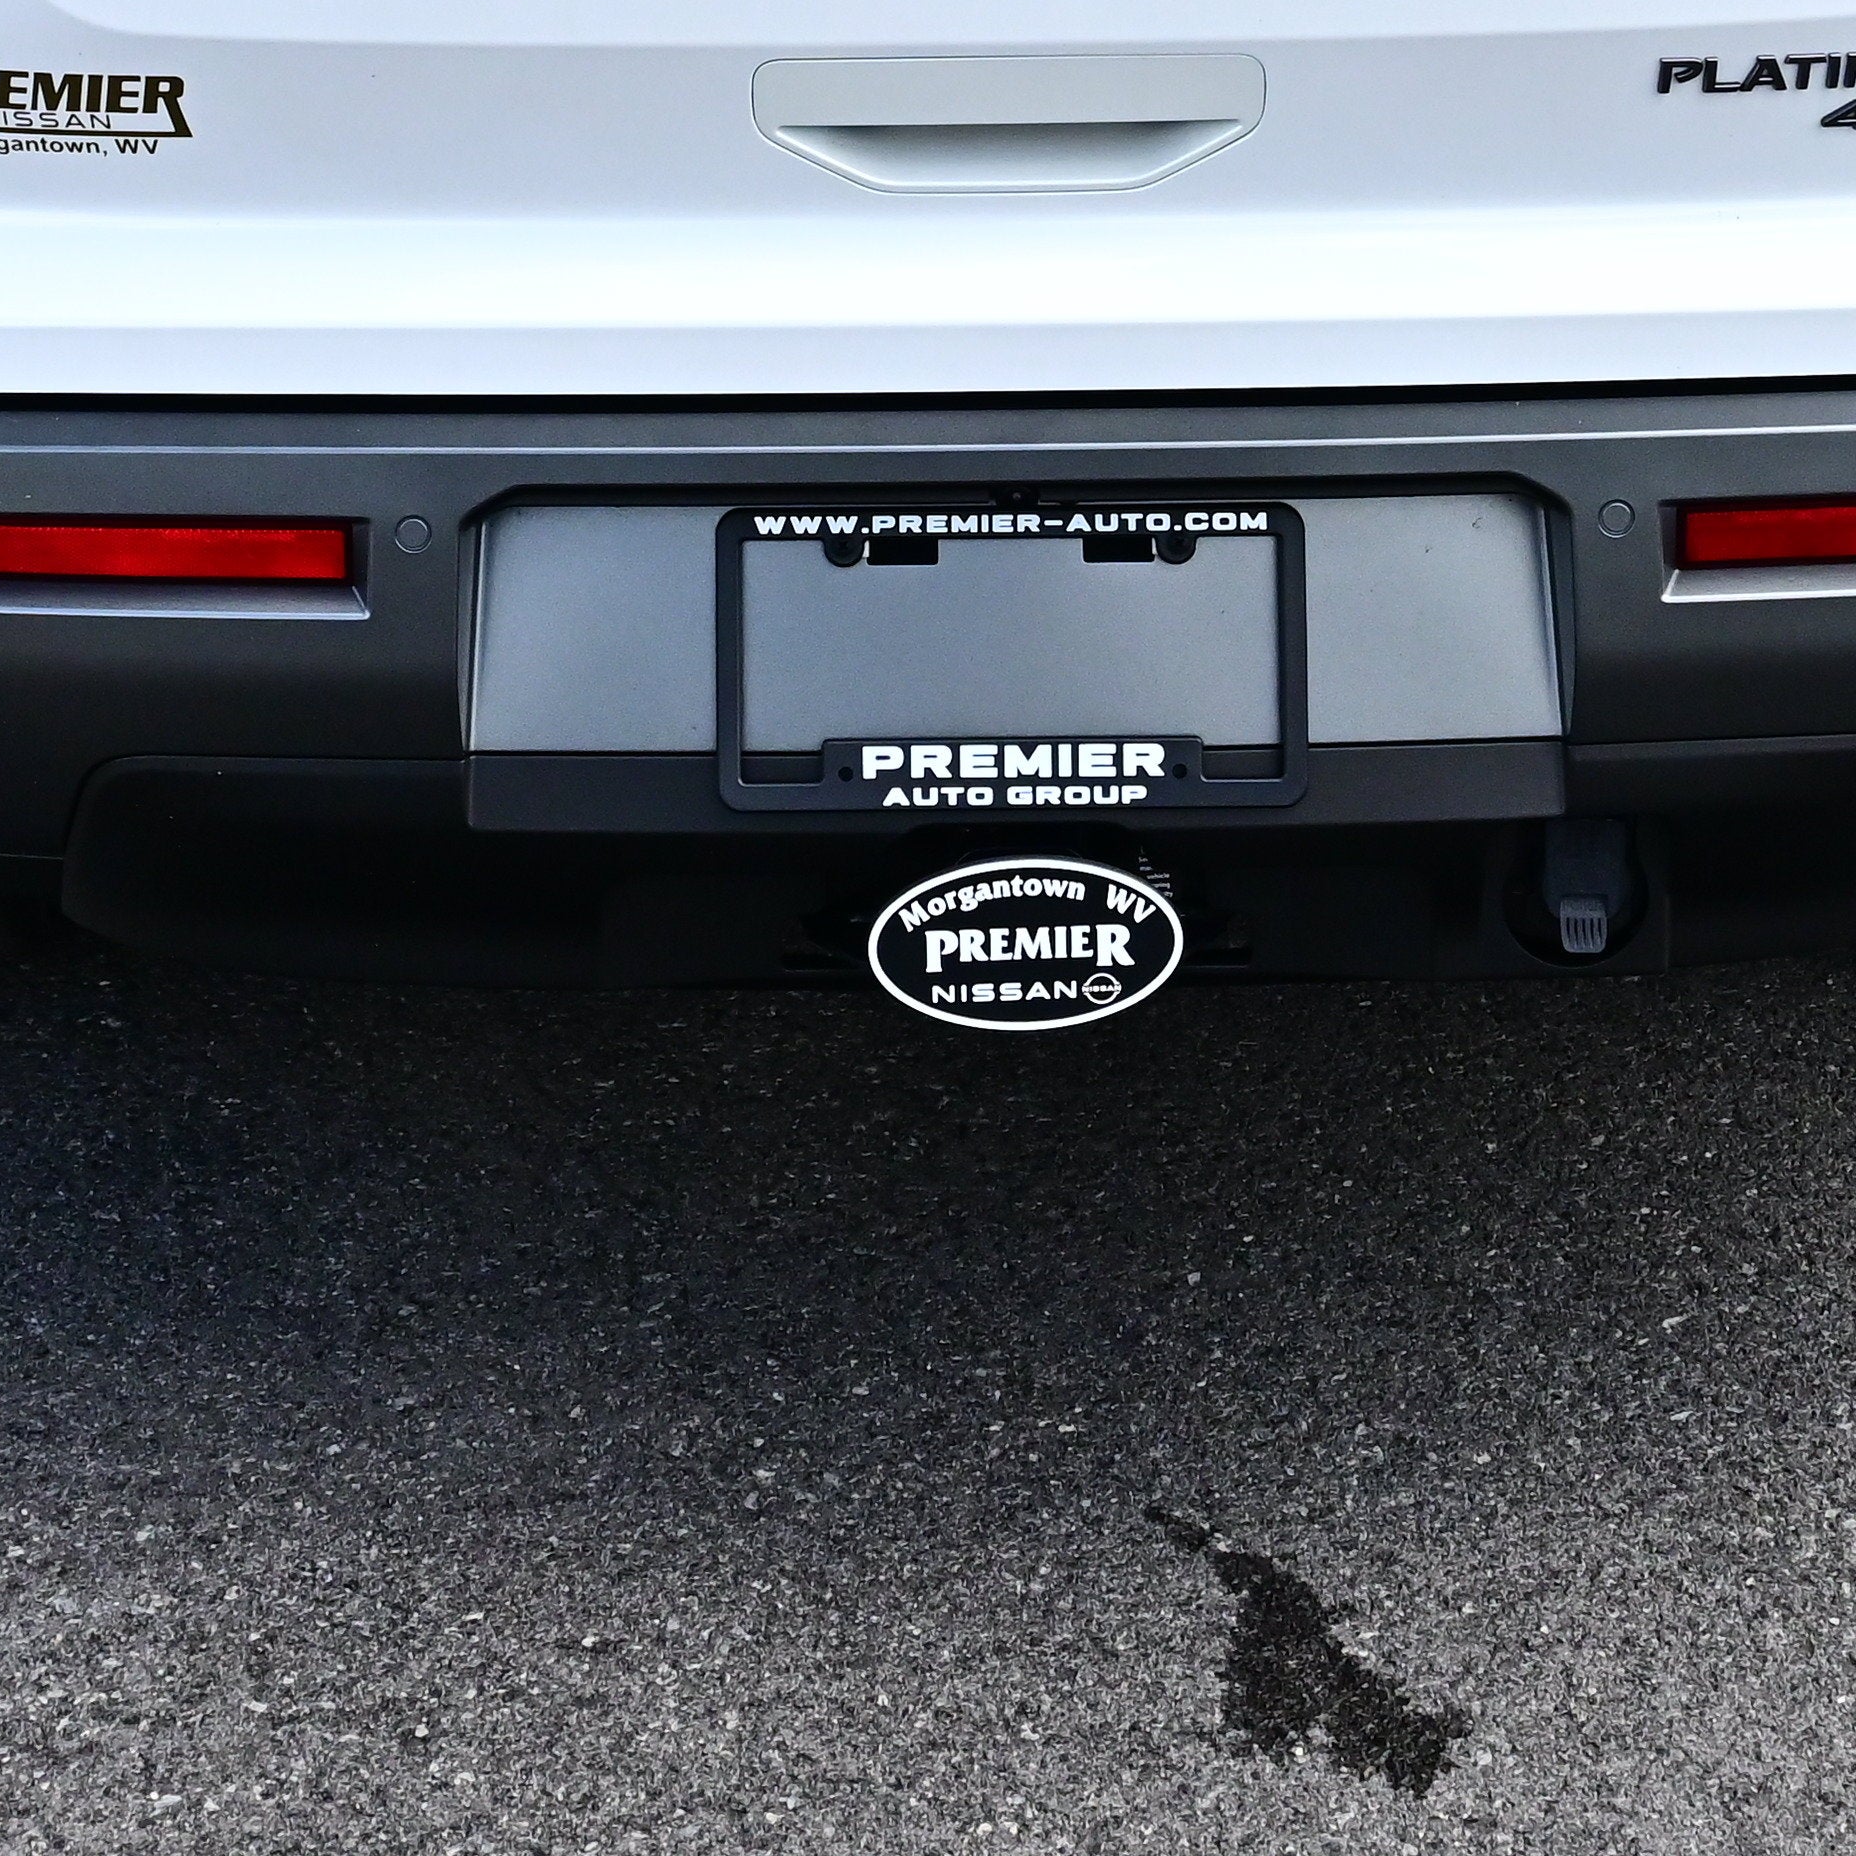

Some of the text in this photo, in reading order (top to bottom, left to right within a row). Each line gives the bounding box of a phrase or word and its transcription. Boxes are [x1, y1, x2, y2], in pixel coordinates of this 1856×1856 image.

[114, 138, 158, 154] WV
[753, 512, 1268, 535] WWW.PREMIER-AUTO.COM
[861, 742, 1166, 780] PREMIER
[882, 785, 1148, 807] AUTO GROUP
[898, 874, 1157, 932] Morgantown WV
[925, 924, 1135, 973] PREMIER
[932, 980, 1078, 1004] NISSAN
